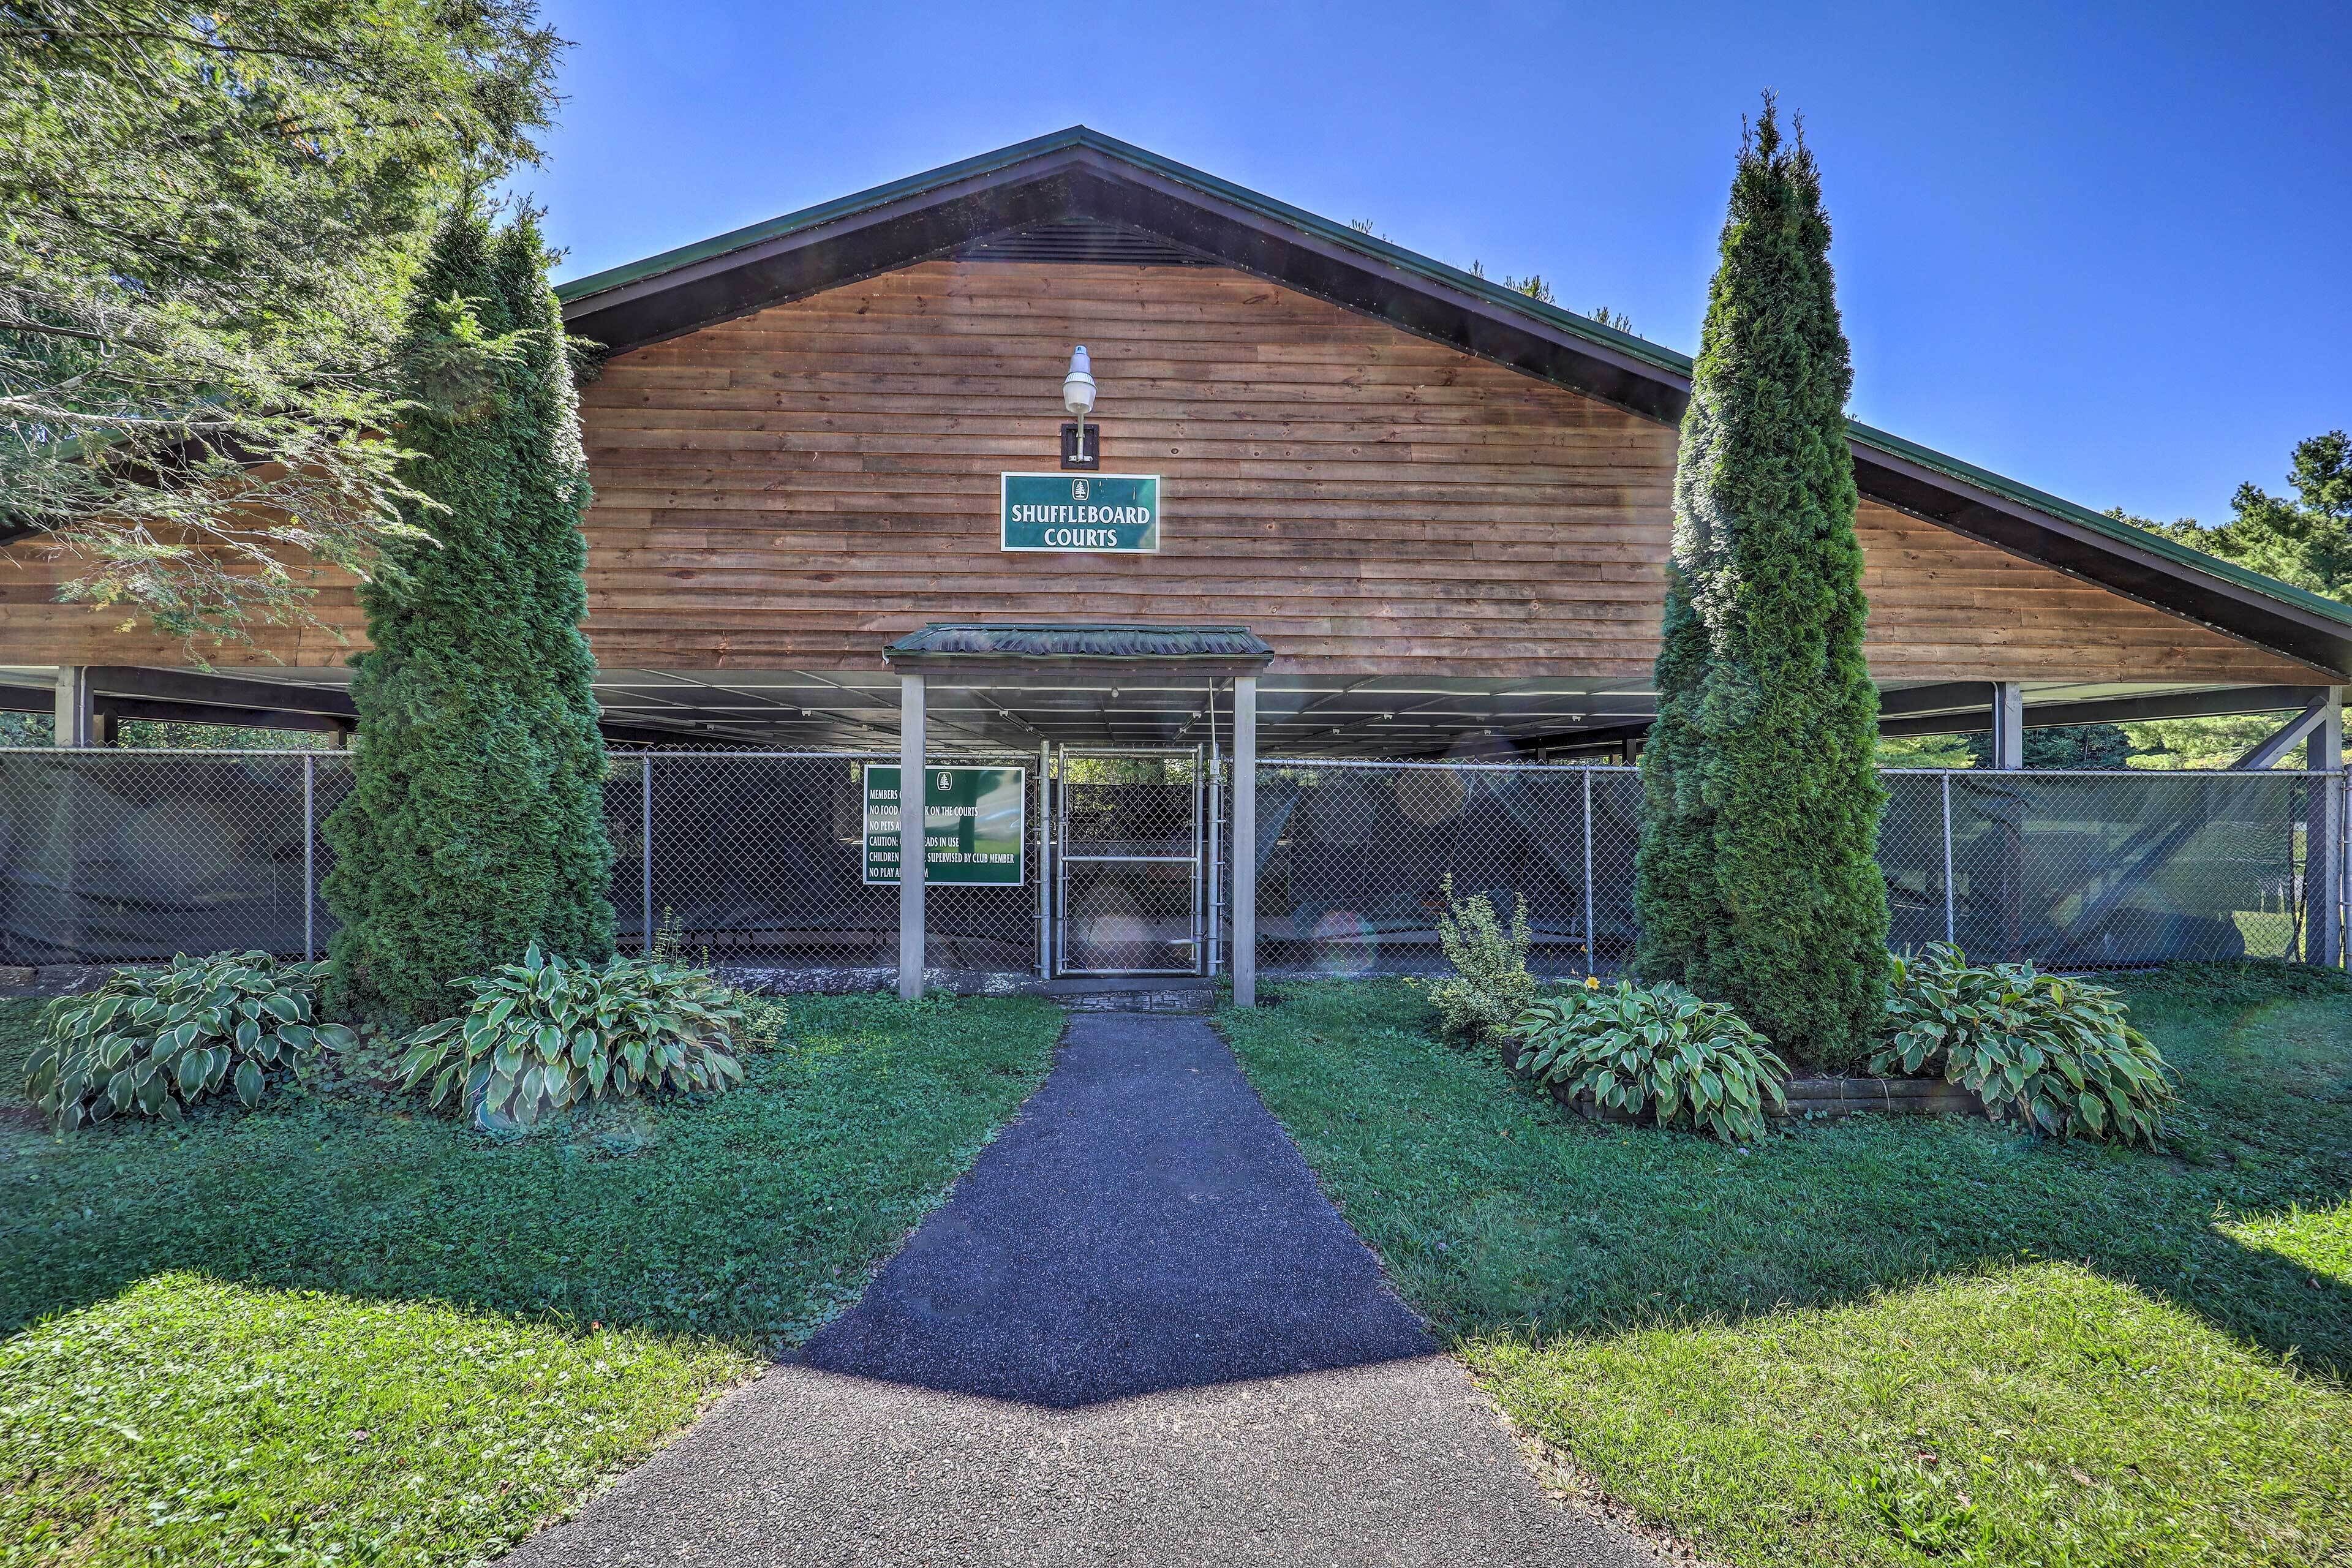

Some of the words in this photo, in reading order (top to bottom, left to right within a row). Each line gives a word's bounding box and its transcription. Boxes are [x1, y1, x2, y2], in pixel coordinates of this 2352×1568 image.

[1011, 504, 1150, 524] SHUFFLEBOARD
[1044, 528, 1117, 547] COURTS
[869, 790, 898, 799] MEMBERS
[869, 805, 880, 815] NO
[881, 805, 898, 815] FOOD
[930, 805, 940, 816] ON
[941, 806, 952, 816] THE
[954, 806, 978, 816] COURTS
[869, 821, 879, 831] NO
[880, 821, 894, 831] PETS
[869, 836, 899, 846] CAUTION:
[940, 837, 947, 847] IN
[948, 837, 959, 847] USE
[869, 851, 899, 862] CHILDREN
[927, 853, 962, 863] SUPERVISED
[963, 853, 971, 863] BY
[972, 853, 988, 863] CLUB
[989, 853, 1014, 864] MEMBER
[869, 867, 879, 877] NO
[880, 867, 895, 878] PLAY
